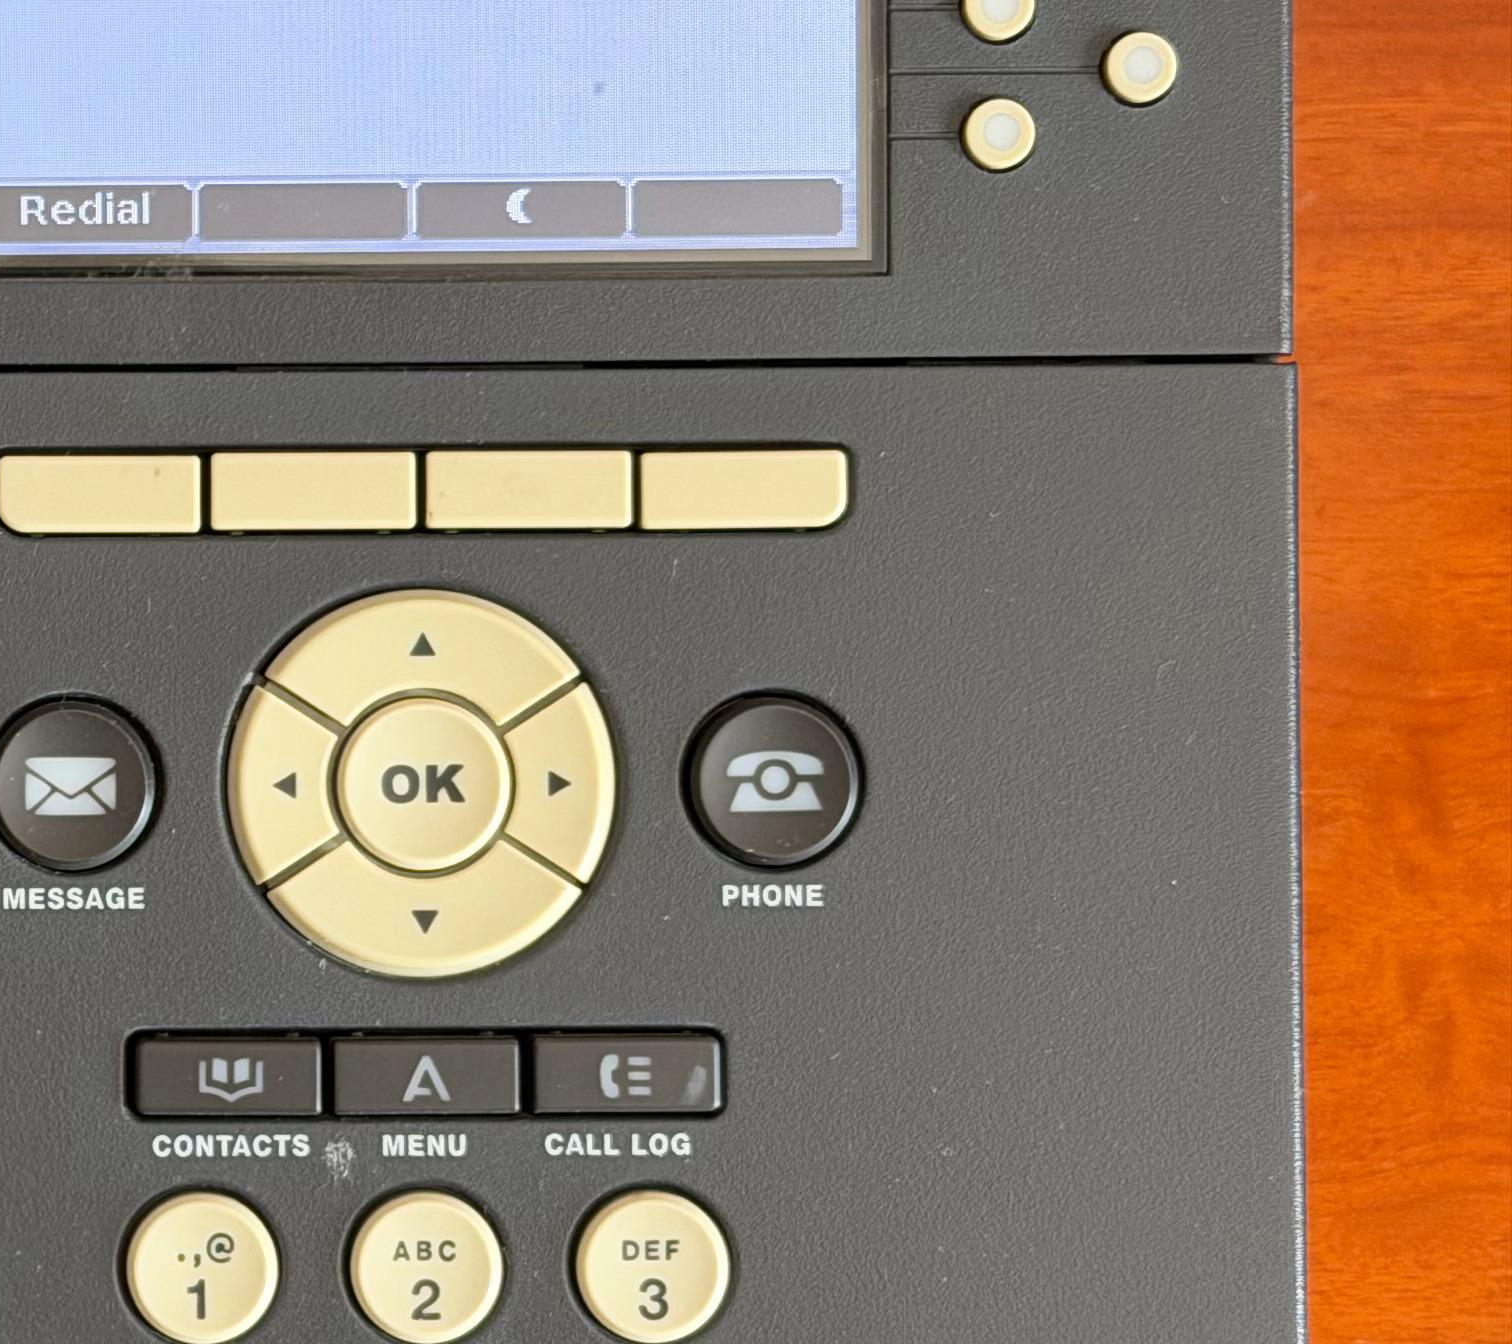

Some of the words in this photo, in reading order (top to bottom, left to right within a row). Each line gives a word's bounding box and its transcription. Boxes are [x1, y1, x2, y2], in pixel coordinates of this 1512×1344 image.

[21, 192, 149, 225] Redial
[382, 764, 465, 803] OK
[3, 887, 144, 909] MESSAGE
[722, 885, 823, 906] PHONE
[153, 1134, 310, 1157] CONTACTS
[383, 1134, 466, 1156] MENU
[545, 1133, 620, 1155] CALL
[632, 1133, 690, 1156] LOG
[394, 1240, 456, 1262] ABC
[623, 1240, 680, 1260] DEF
[188, 1279, 205, 1319] 1
[412, 1279, 441, 1320] 2
[639, 1279, 668, 1320] 3
